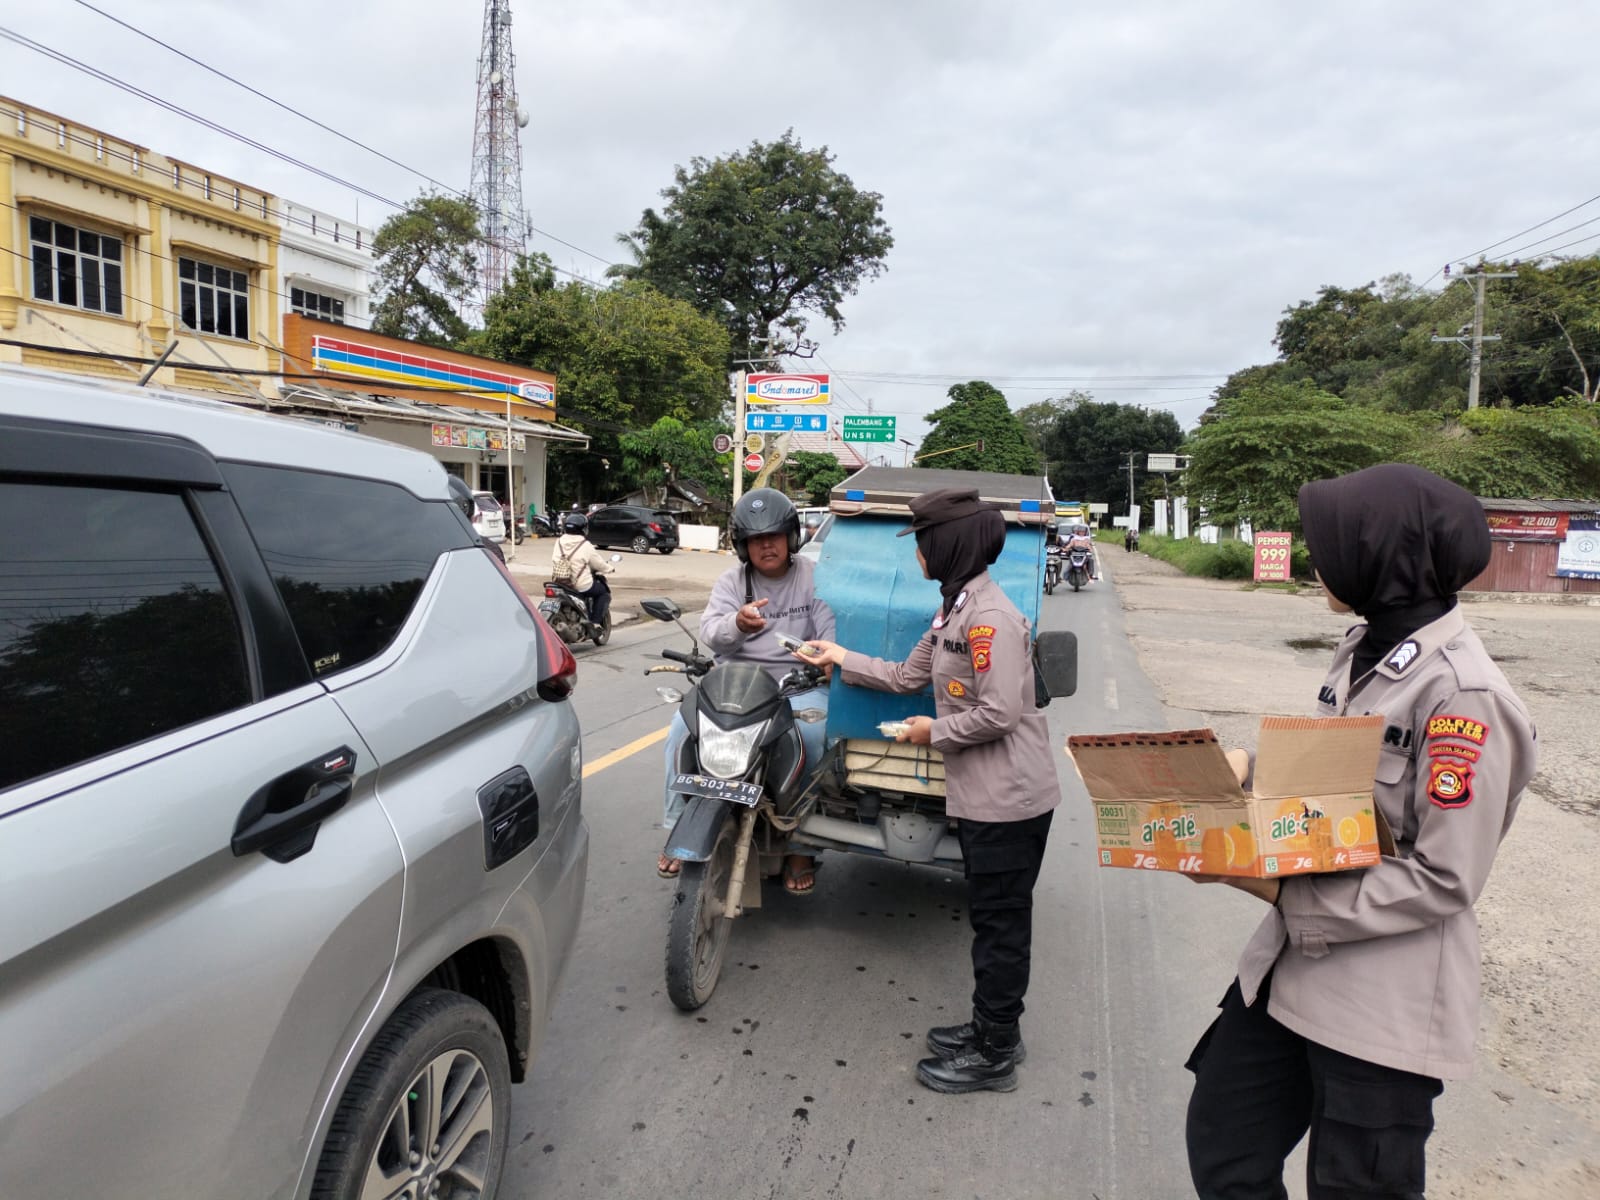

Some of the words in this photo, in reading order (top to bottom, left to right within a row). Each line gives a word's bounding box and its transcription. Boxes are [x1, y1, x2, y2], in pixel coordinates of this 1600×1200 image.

[762, 383, 815, 394] Indomaret
[845, 418, 882, 426] PALEMBANG
[1257, 536, 1290, 546] PEMPEK
[1260, 548, 1287, 561] 999
[1429, 718, 1483, 733] POLRES
[676, 775, 695, 784] BG
[741, 783, 757, 794] TR
[1100, 808, 1123, 817] 50031
